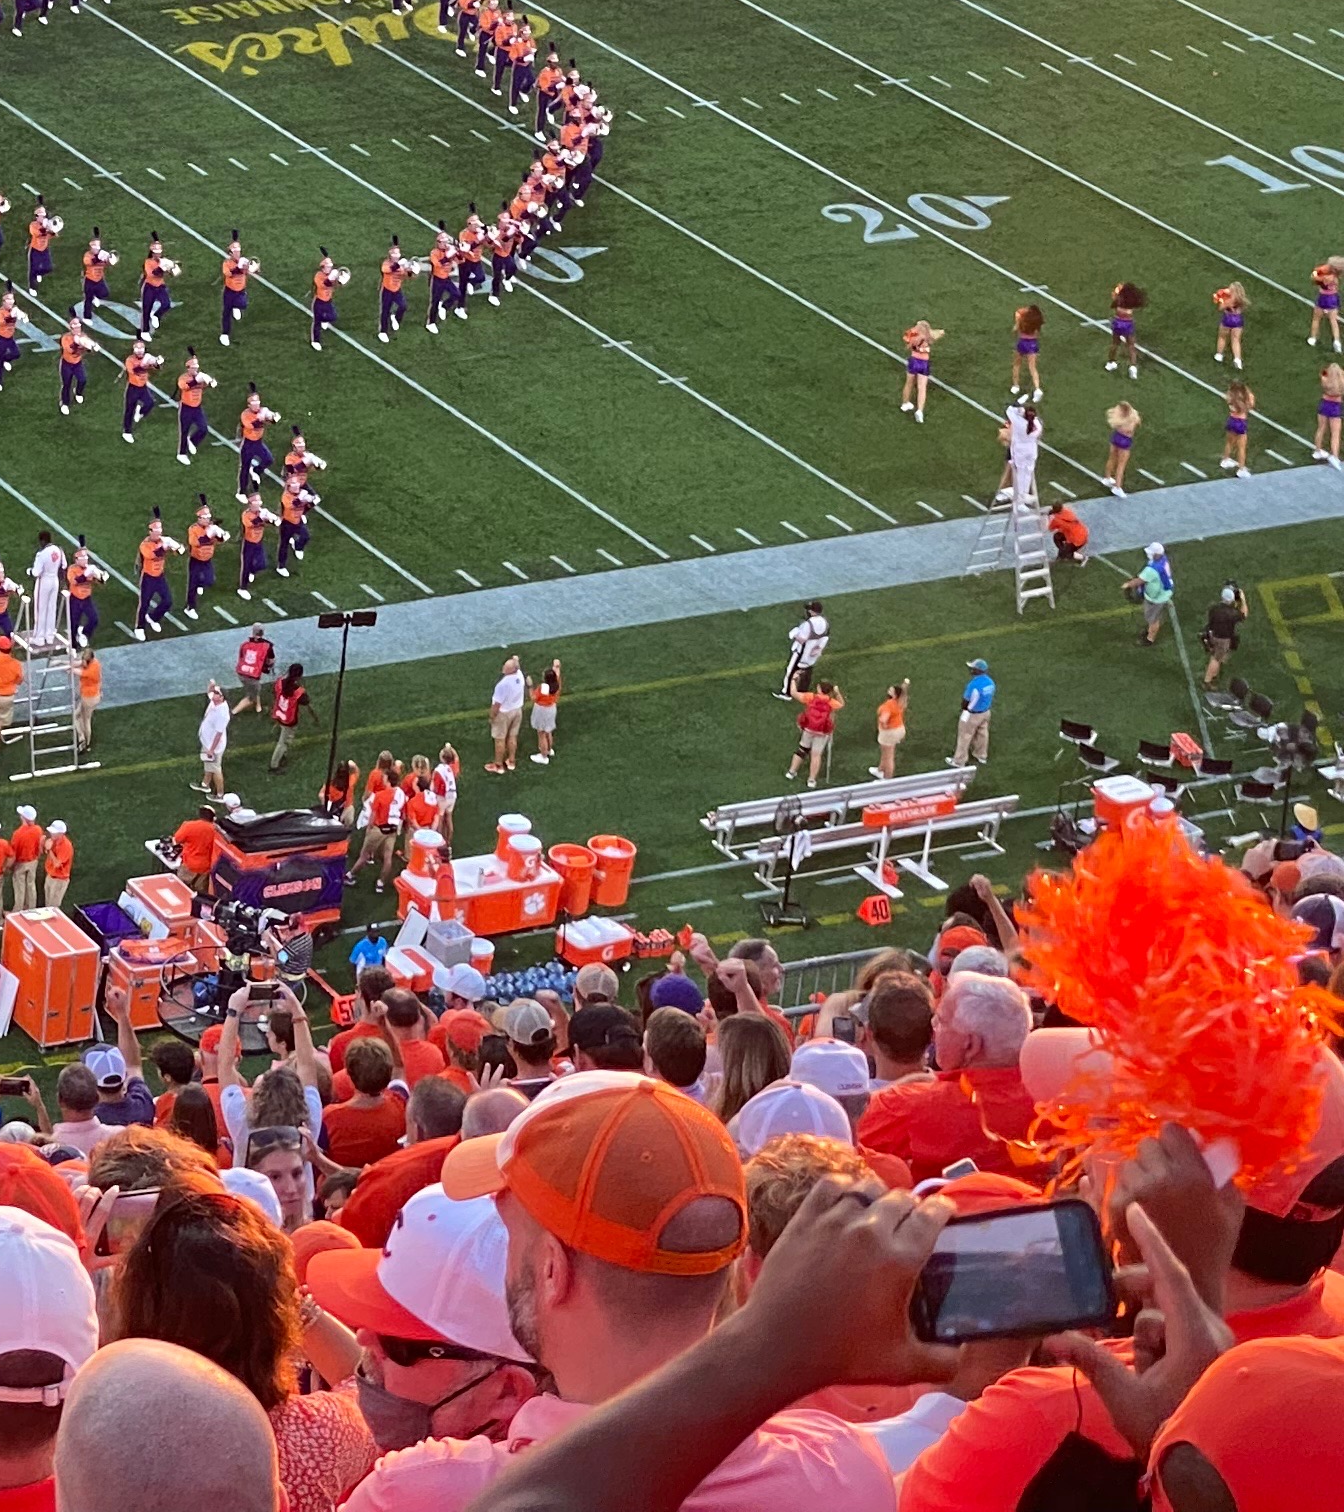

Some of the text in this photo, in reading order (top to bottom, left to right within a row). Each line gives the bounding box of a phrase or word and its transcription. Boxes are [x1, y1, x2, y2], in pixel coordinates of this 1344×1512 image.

[821, 192, 993, 245] 20
[889, 804, 937, 821] GATORADE
[263, 876, 323, 898] CLEMSON
[871, 899, 890, 921] 40
[601, 944, 615, 962] G
